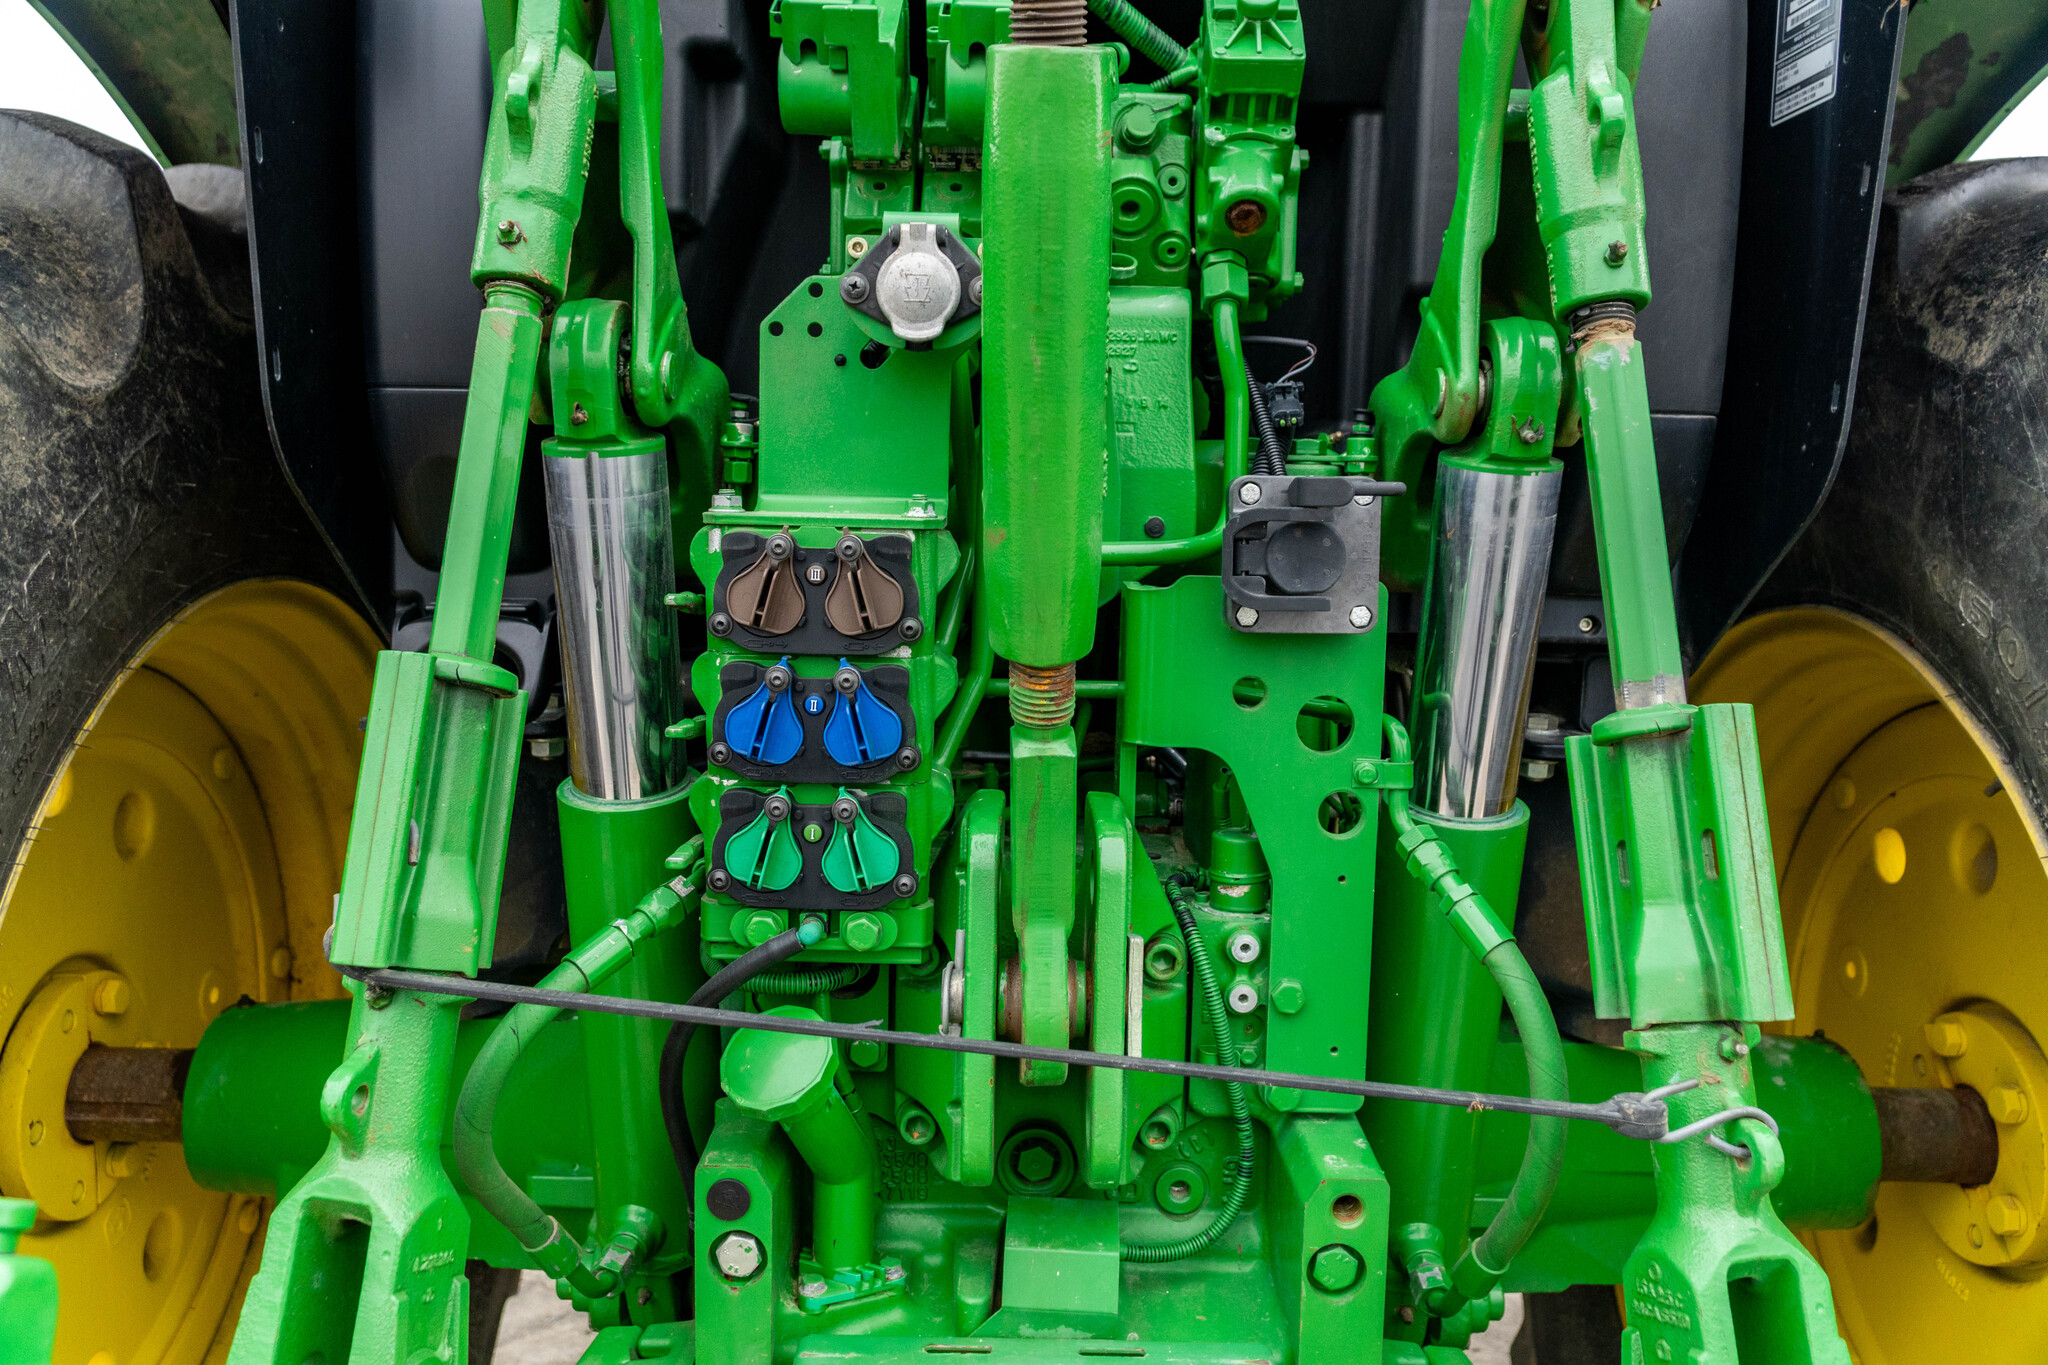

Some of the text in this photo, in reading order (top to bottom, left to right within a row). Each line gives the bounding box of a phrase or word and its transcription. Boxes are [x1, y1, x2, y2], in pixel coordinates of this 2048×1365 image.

[810, 568, 821, 581] III
[810, 699, 818, 712] II
[809, 828, 816, 840] I
